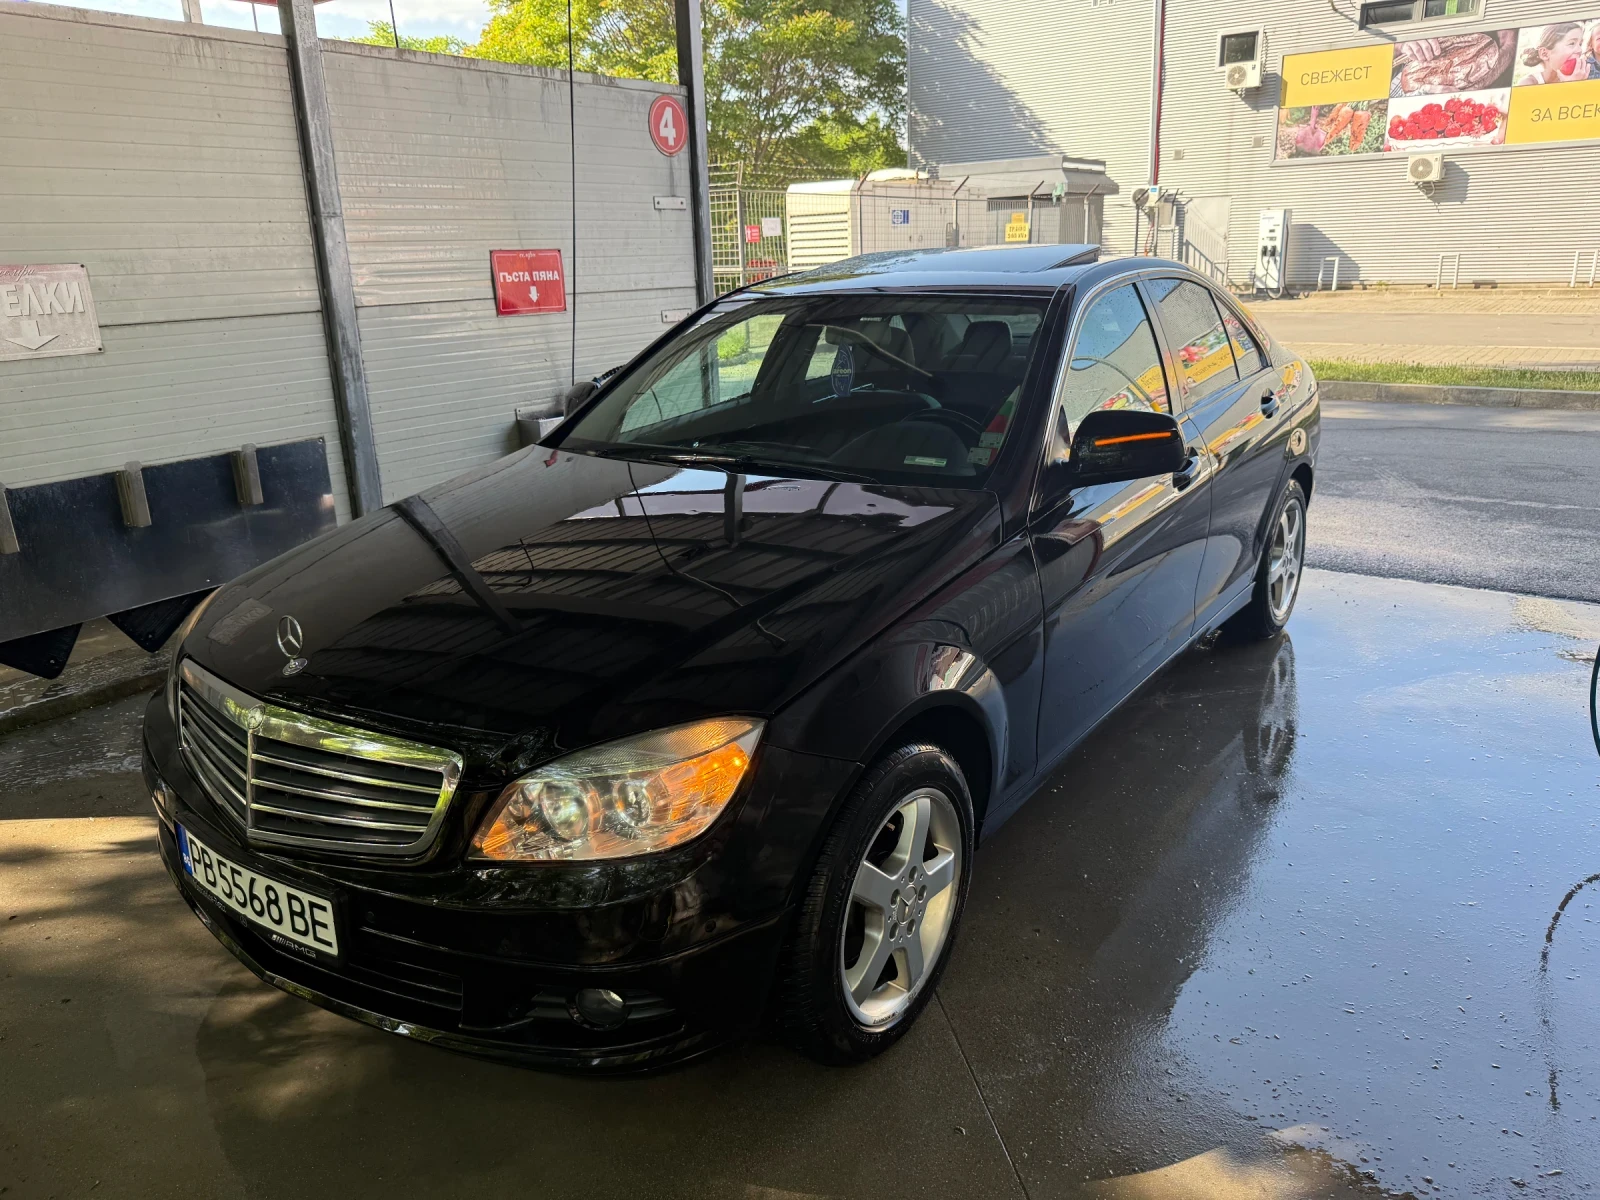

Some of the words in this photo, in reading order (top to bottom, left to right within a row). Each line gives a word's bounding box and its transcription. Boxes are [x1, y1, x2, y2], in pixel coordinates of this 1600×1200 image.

[1300, 66, 1372, 86] СВЕЖЕСТ
[1531, 108, 1552, 122] ЗА
[659, 106, 676, 146] 4
[500, 271, 531, 283] ГЪСТА
[532, 270, 560, 281] ПЯНА
